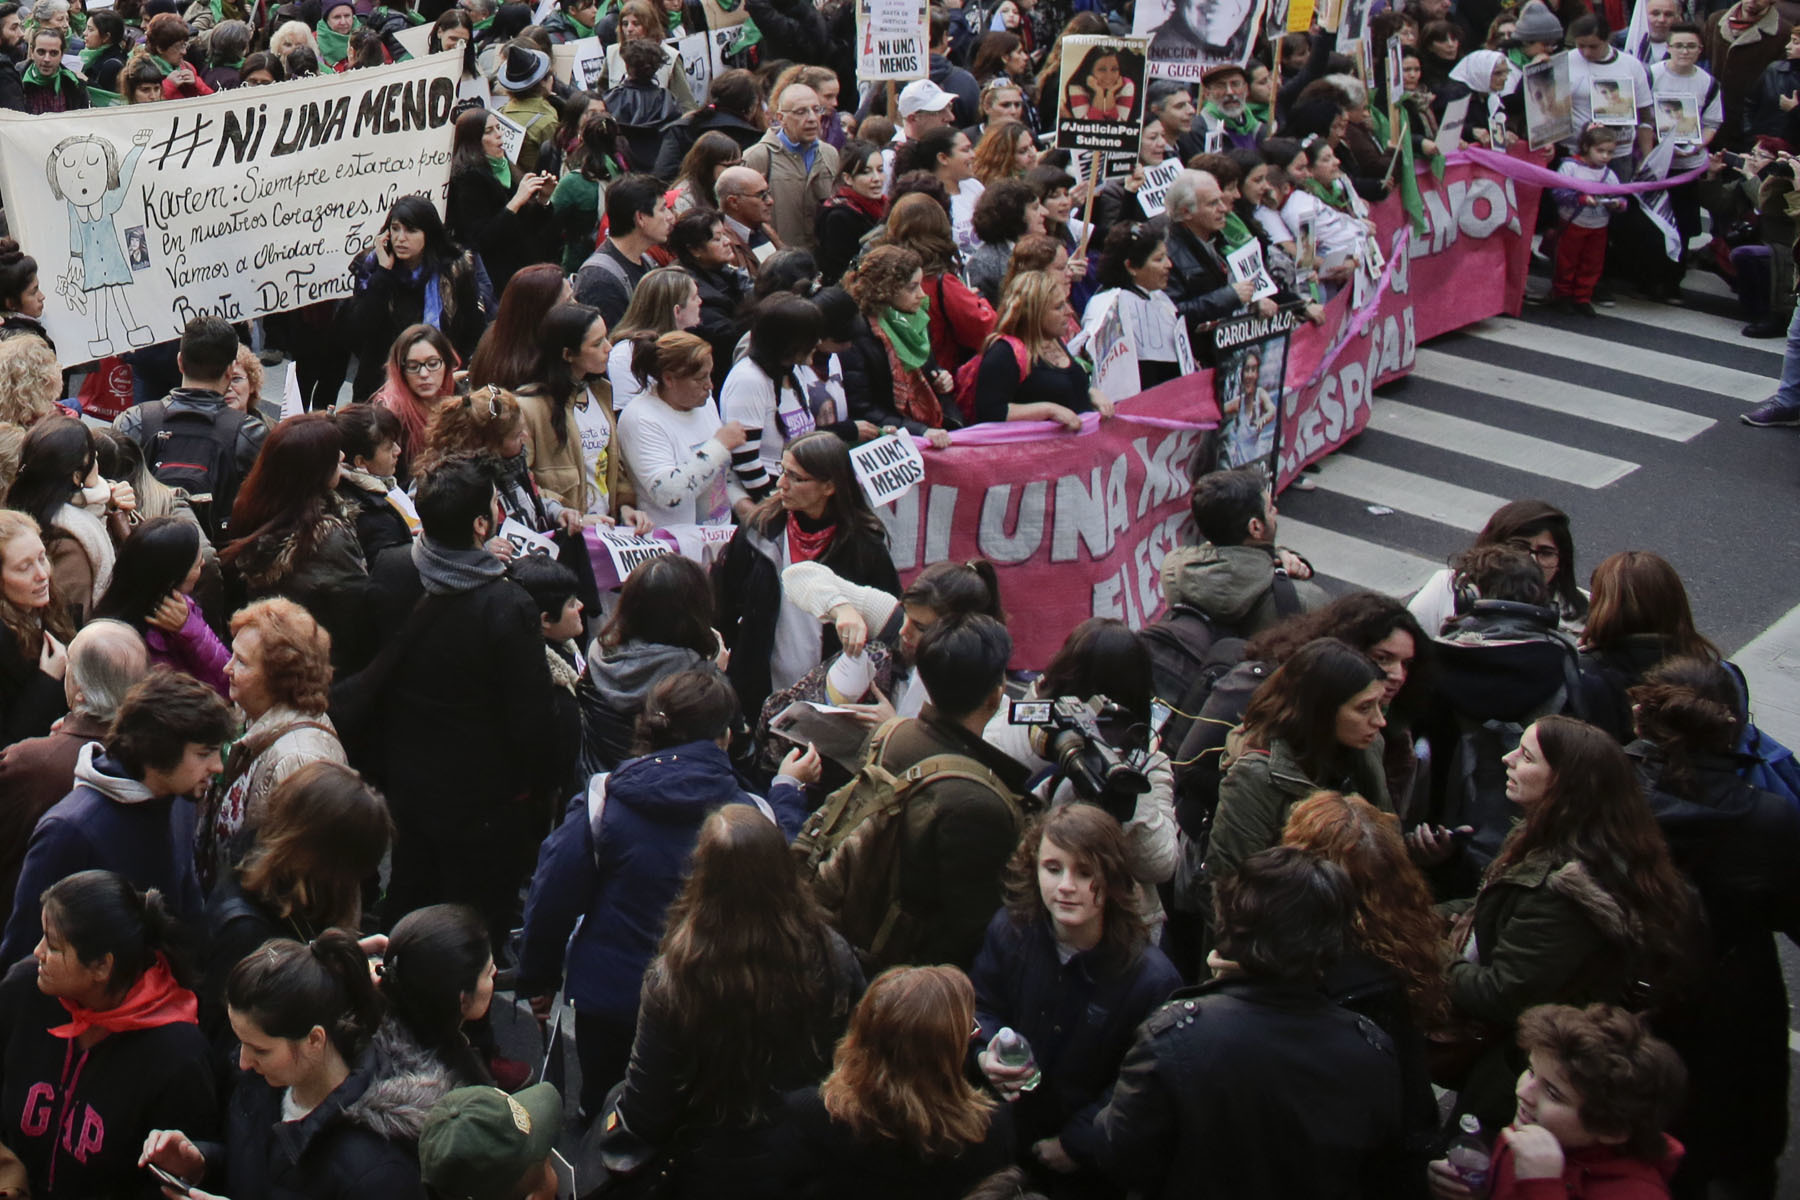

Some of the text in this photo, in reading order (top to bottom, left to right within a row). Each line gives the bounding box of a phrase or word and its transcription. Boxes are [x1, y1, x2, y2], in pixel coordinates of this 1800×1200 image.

[878, 38, 916, 56] NI UNA
[880, 56, 918, 74] MENOS
[270, 96, 352, 158] UNA
[1061, 122, 1139, 136] #JusticiaPor
[1076, 135, 1122, 147] Suhene
[240, 164, 331, 204] Siempre
[335, 150, 415, 180] estaras
[161, 231, 186, 256] en
[190, 209, 269, 245] nuestros
[166, 254, 230, 289] Vamos
[235, 257, 248, 273] a
[254, 281, 291, 315] De
[1215, 317, 1270, 350] CAROLINA
[856, 440, 909, 476] NI UNA
[870, 460, 923, 498] MENOS
[978, 451, 1130, 565] UNA
